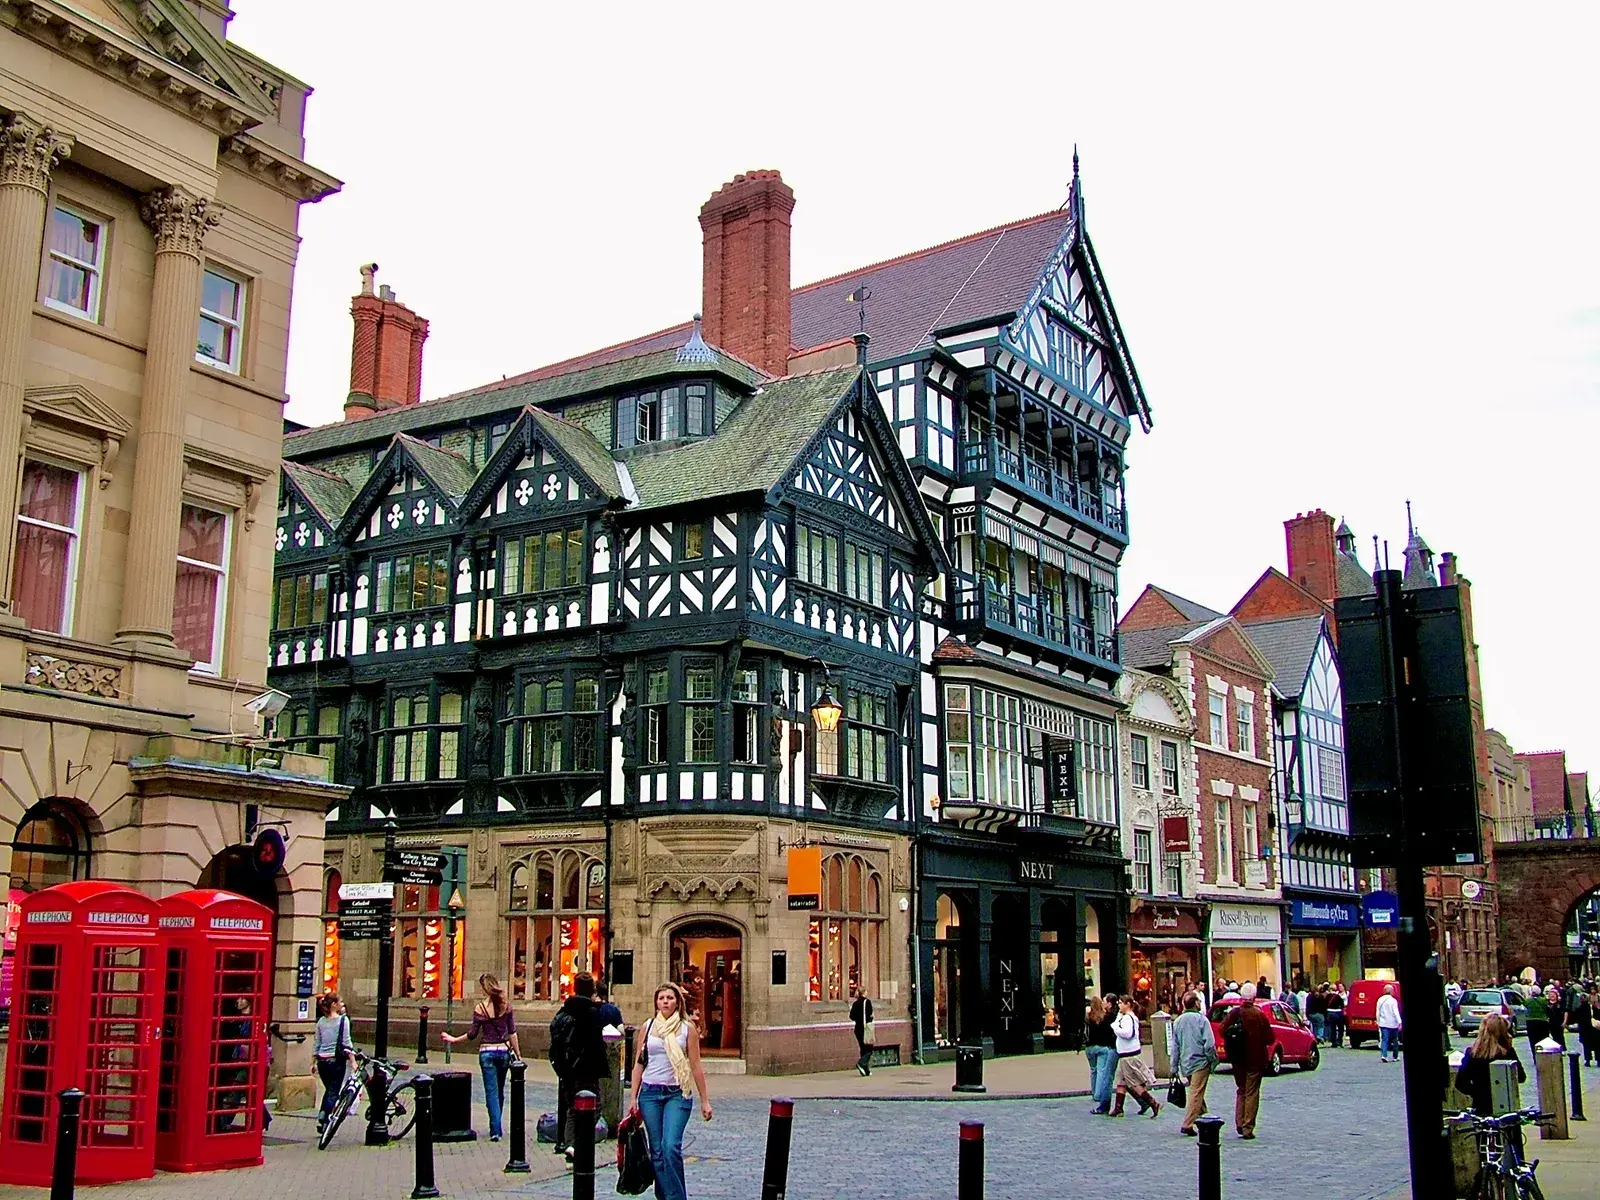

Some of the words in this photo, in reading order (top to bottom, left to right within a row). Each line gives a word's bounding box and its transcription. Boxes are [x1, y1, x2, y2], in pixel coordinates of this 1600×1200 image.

[1058, 753, 1068, 797] NEXT
[410, 858, 421, 867] City
[421, 854, 439, 862] Station
[1020, 861, 1054, 880] NEXT
[30, 912, 70, 922] TELEPHONE
[91, 912, 146, 923] TELEPHONE
[160, 917, 193, 927] LEPHONE
[212, 917, 261, 928] TELEPHONE
[1000, 959, 1012, 1031] NEXT
